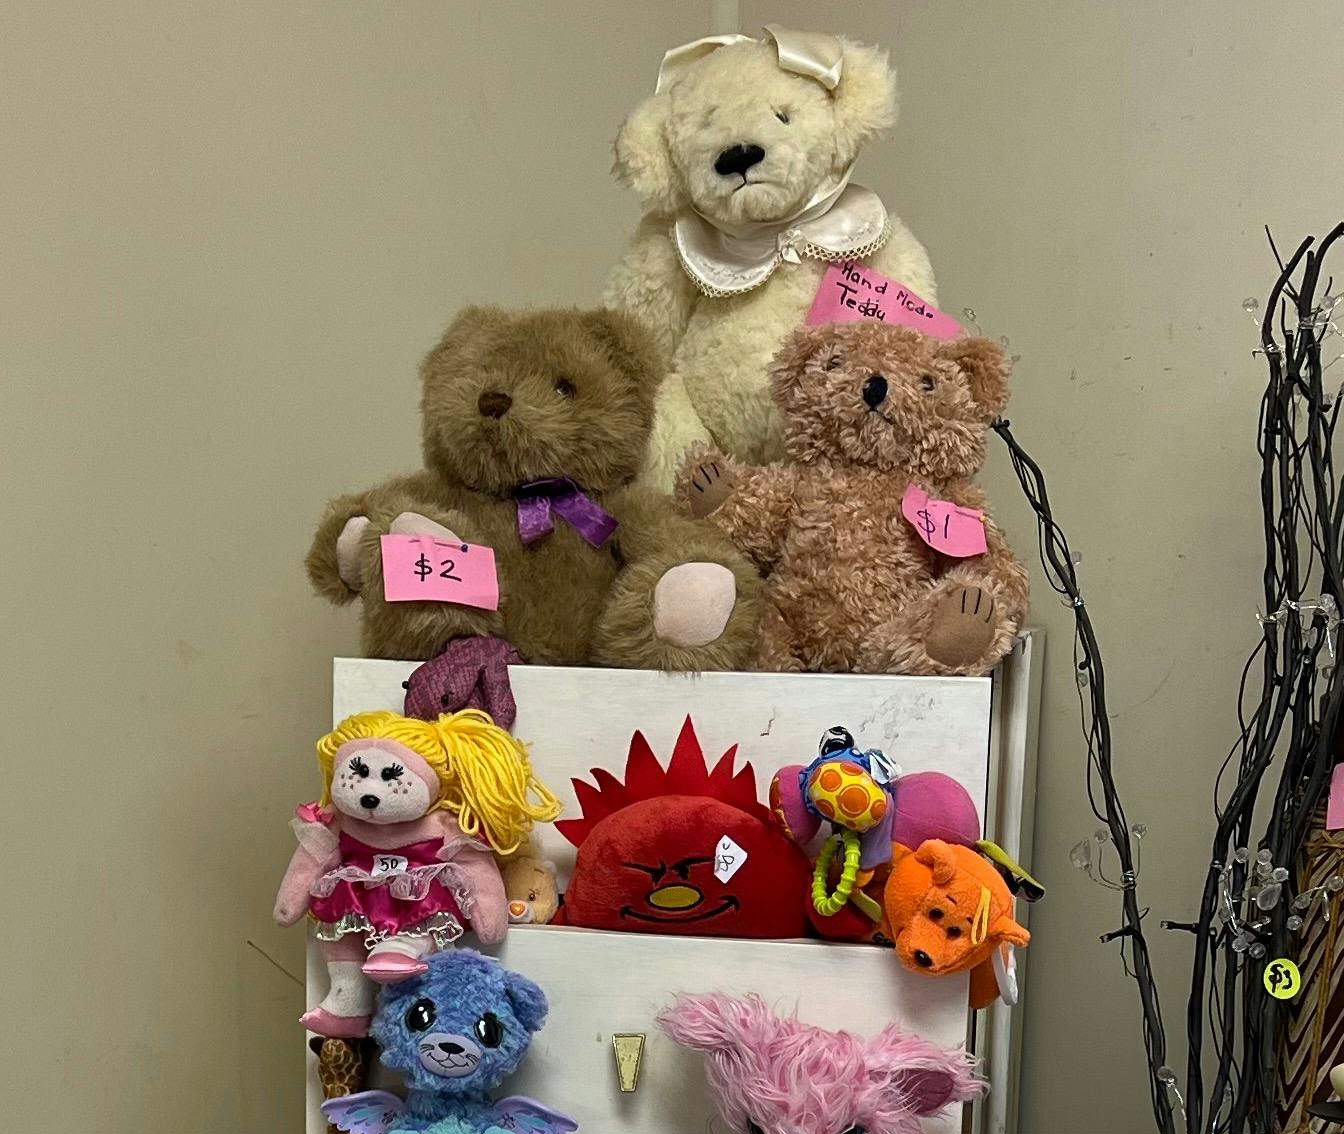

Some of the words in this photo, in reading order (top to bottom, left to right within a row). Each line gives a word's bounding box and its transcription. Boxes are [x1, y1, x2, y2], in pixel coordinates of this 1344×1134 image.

[841, 260, 888, 295] Hand
[917, 509, 950, 543] $1
[414, 553, 462, 582] $2
[1268, 963, 1293, 993] $3
